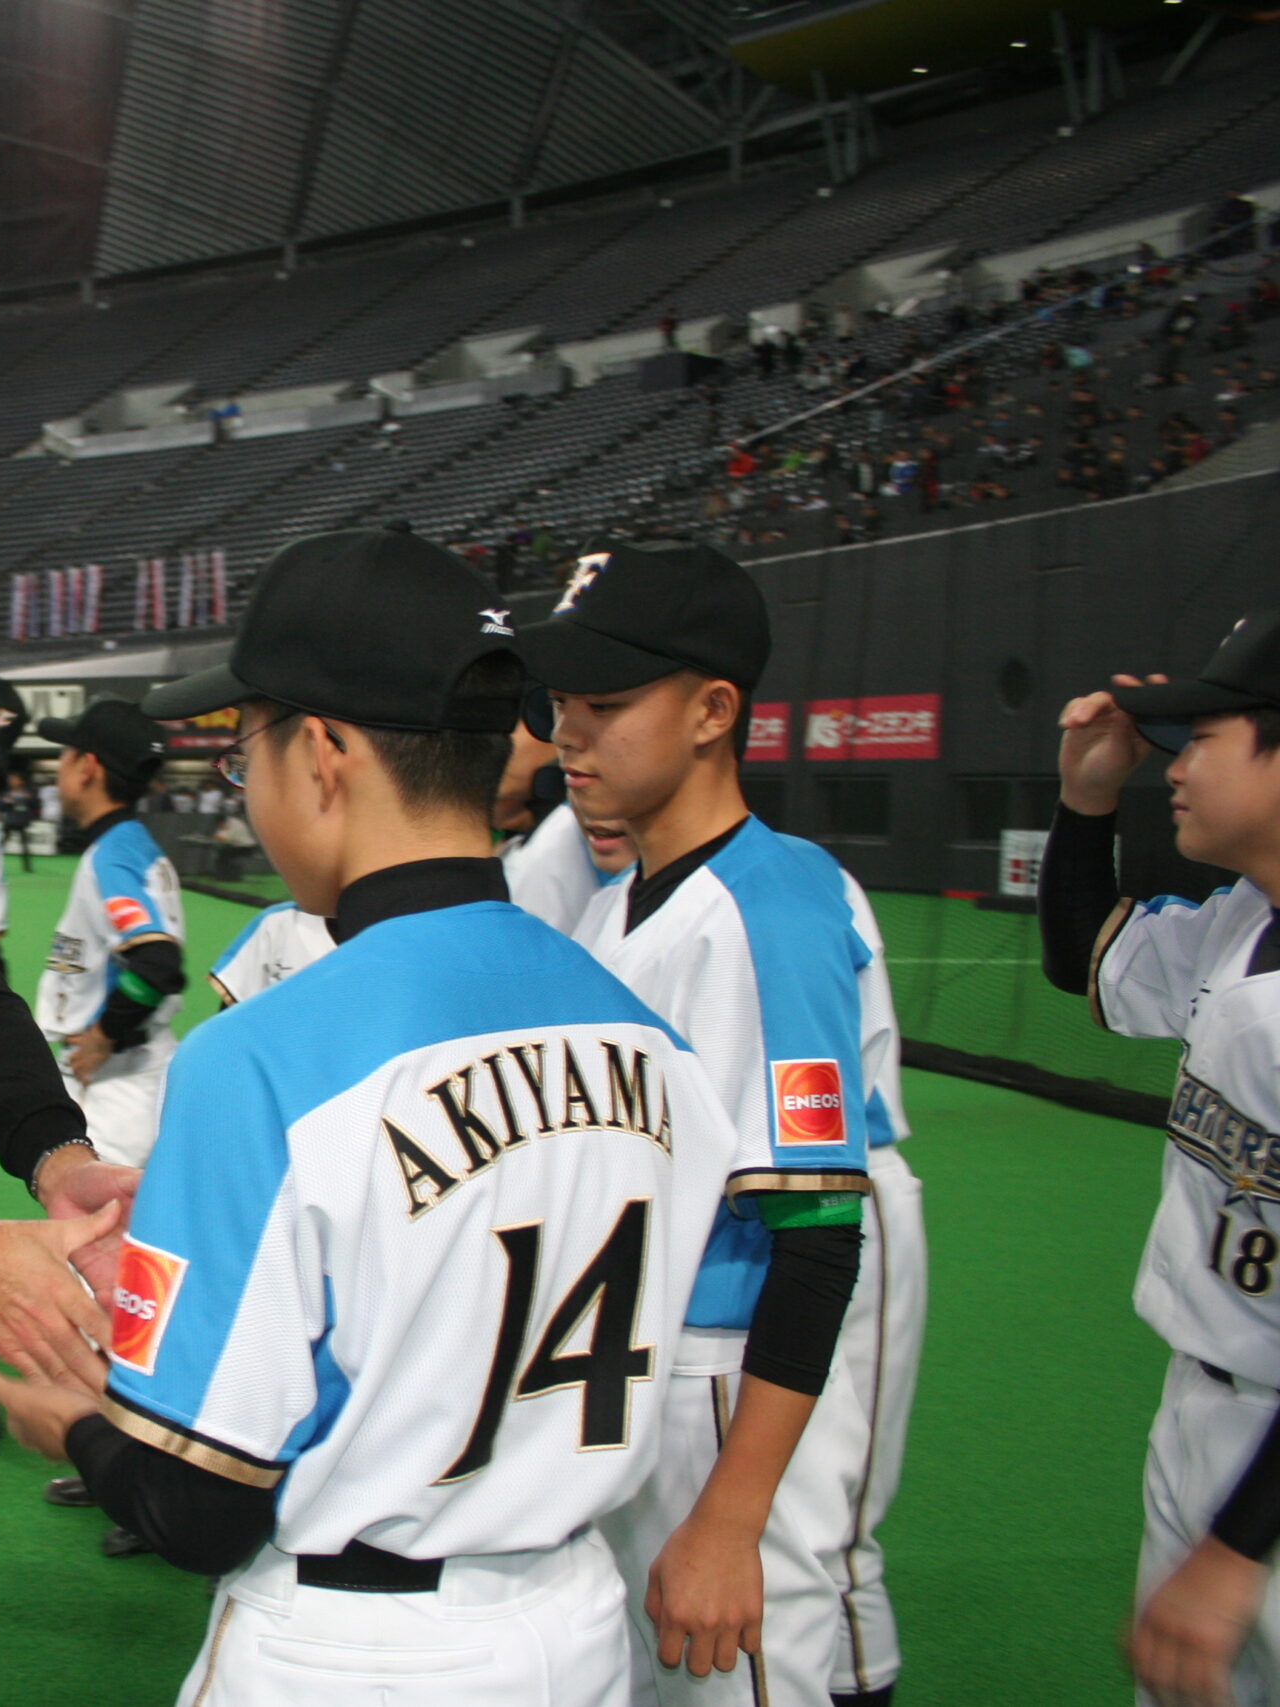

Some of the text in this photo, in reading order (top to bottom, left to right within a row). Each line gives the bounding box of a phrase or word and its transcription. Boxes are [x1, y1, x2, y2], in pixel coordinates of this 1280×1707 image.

[381, 1036, 674, 1222] AKIYAMA
[782, 1093, 841, 1110] ENEOS
[1207, 1207, 1279, 1297] 18
[113, 1287, 157, 1321] EOS
[429, 1195, 656, 1487] 14
